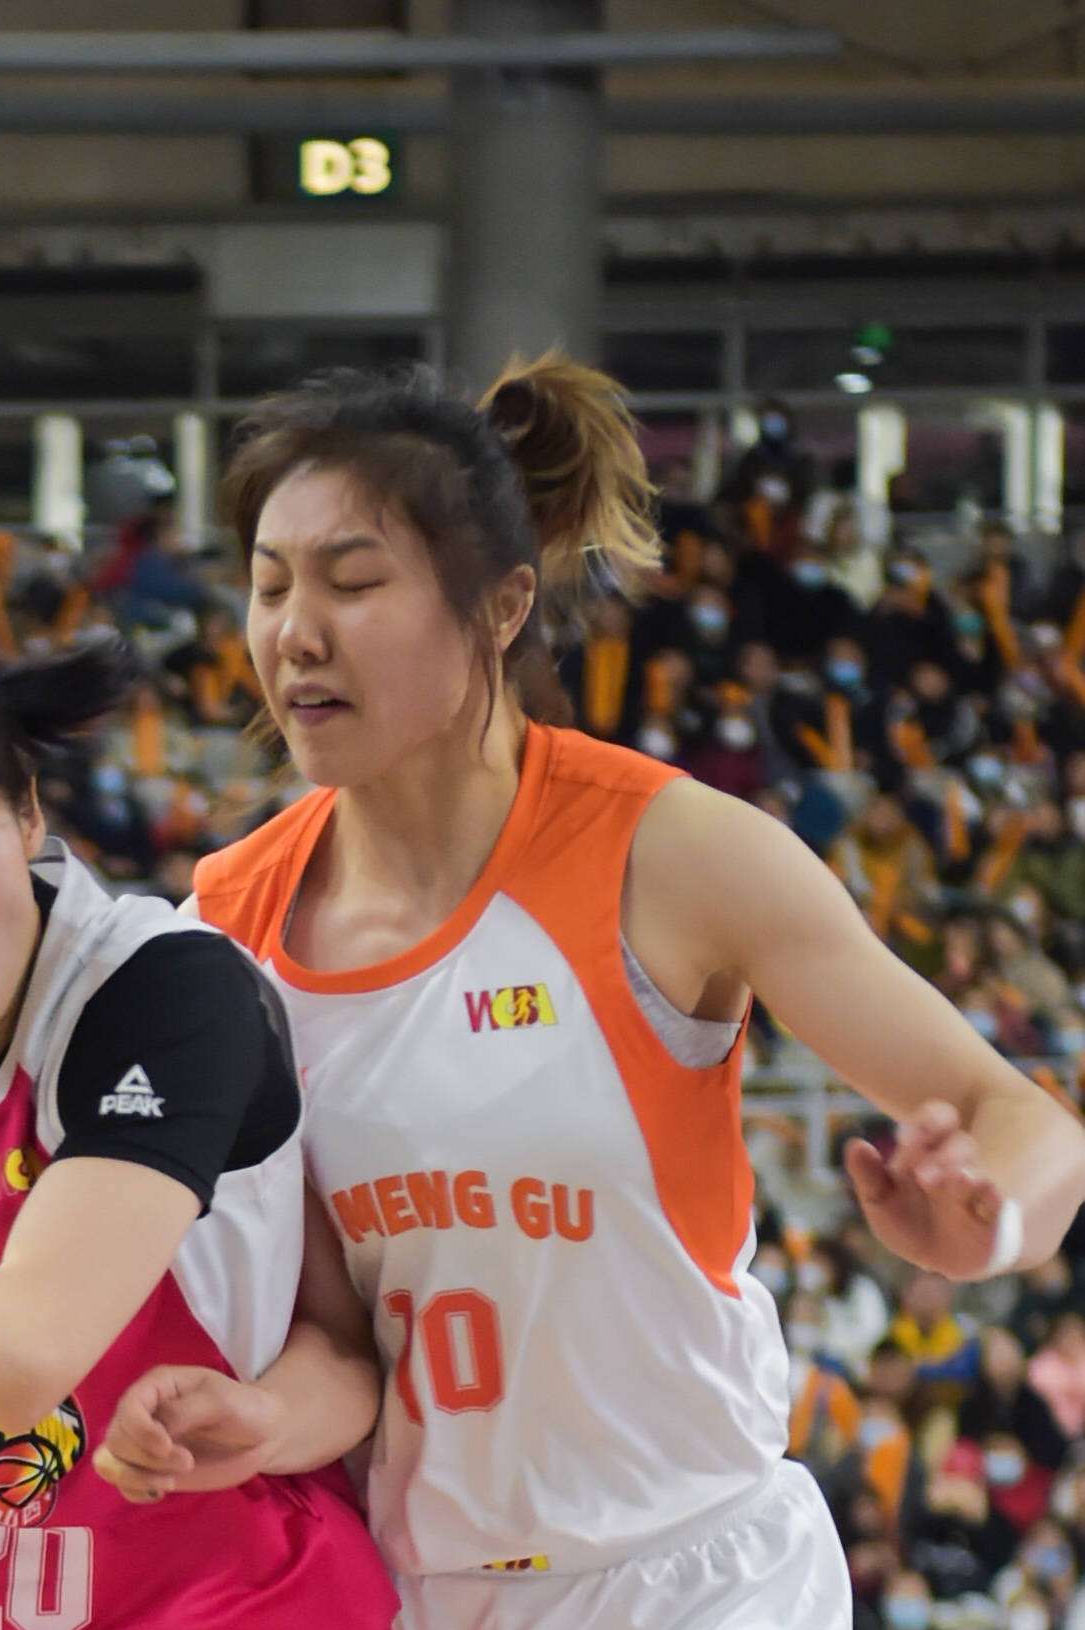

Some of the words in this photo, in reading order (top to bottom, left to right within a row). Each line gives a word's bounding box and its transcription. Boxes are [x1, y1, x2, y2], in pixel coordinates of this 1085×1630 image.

[300, 137, 391, 195] D3
[98, 1094, 165, 1118] PEAK
[331, 1170, 497, 1244] MENG
[510, 1177, 595, 1242] GU
